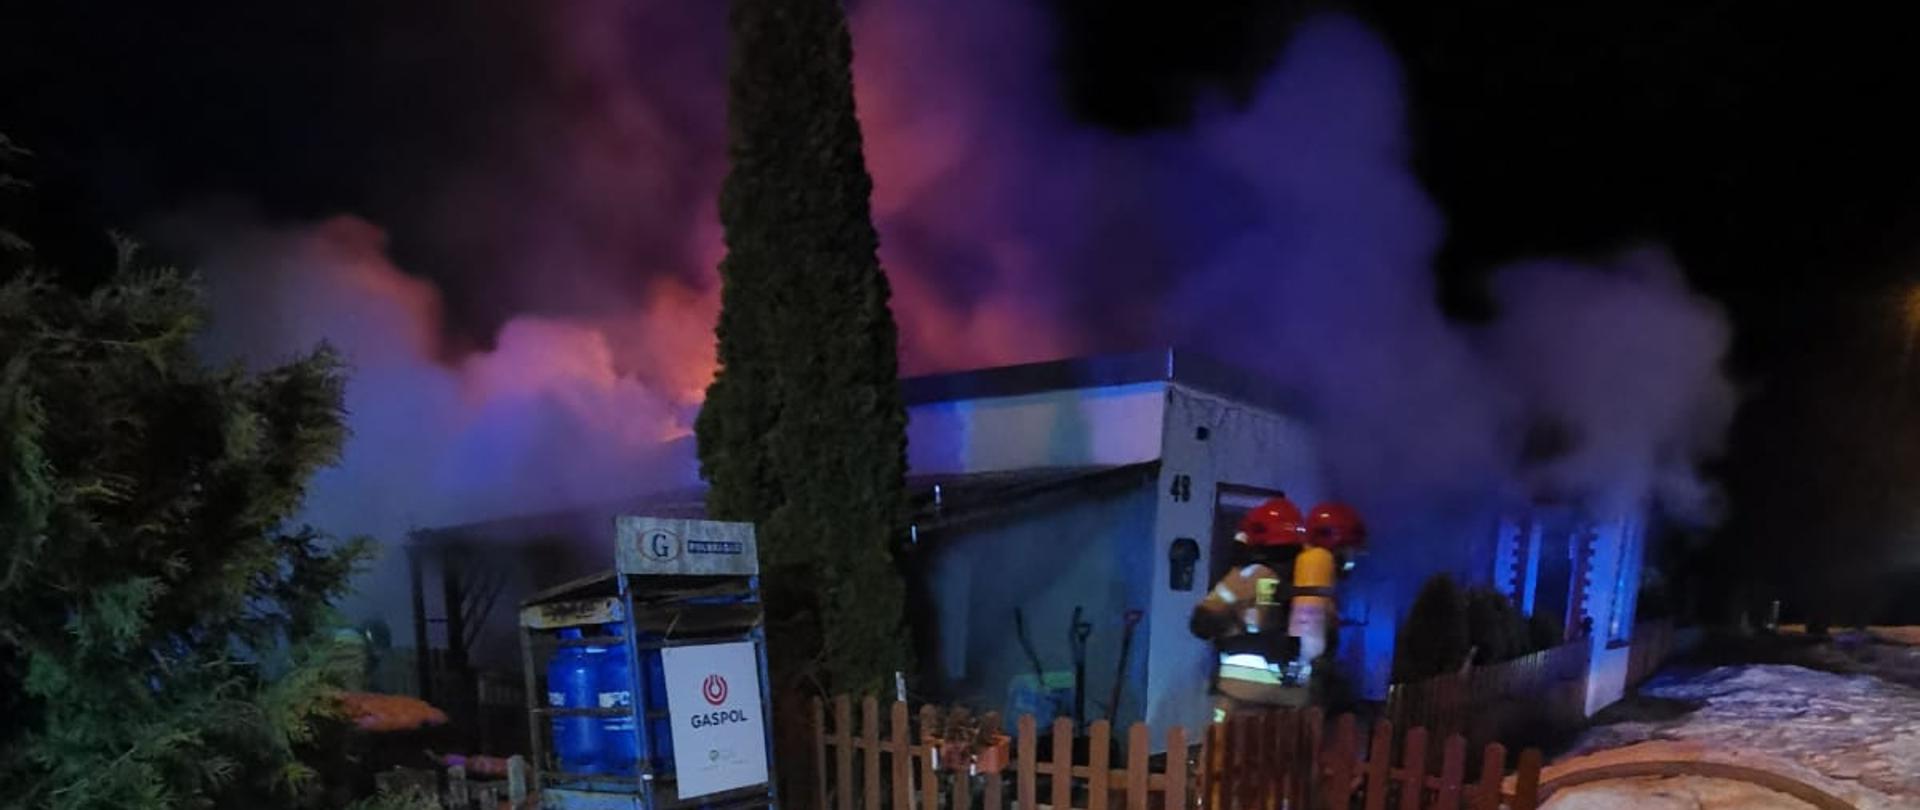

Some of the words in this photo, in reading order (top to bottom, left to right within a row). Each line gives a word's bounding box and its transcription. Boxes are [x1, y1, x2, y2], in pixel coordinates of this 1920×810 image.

[1170, 474, 1191, 502] 48
[652, 533, 669, 557] G
[690, 710, 748, 729] GASPOL
